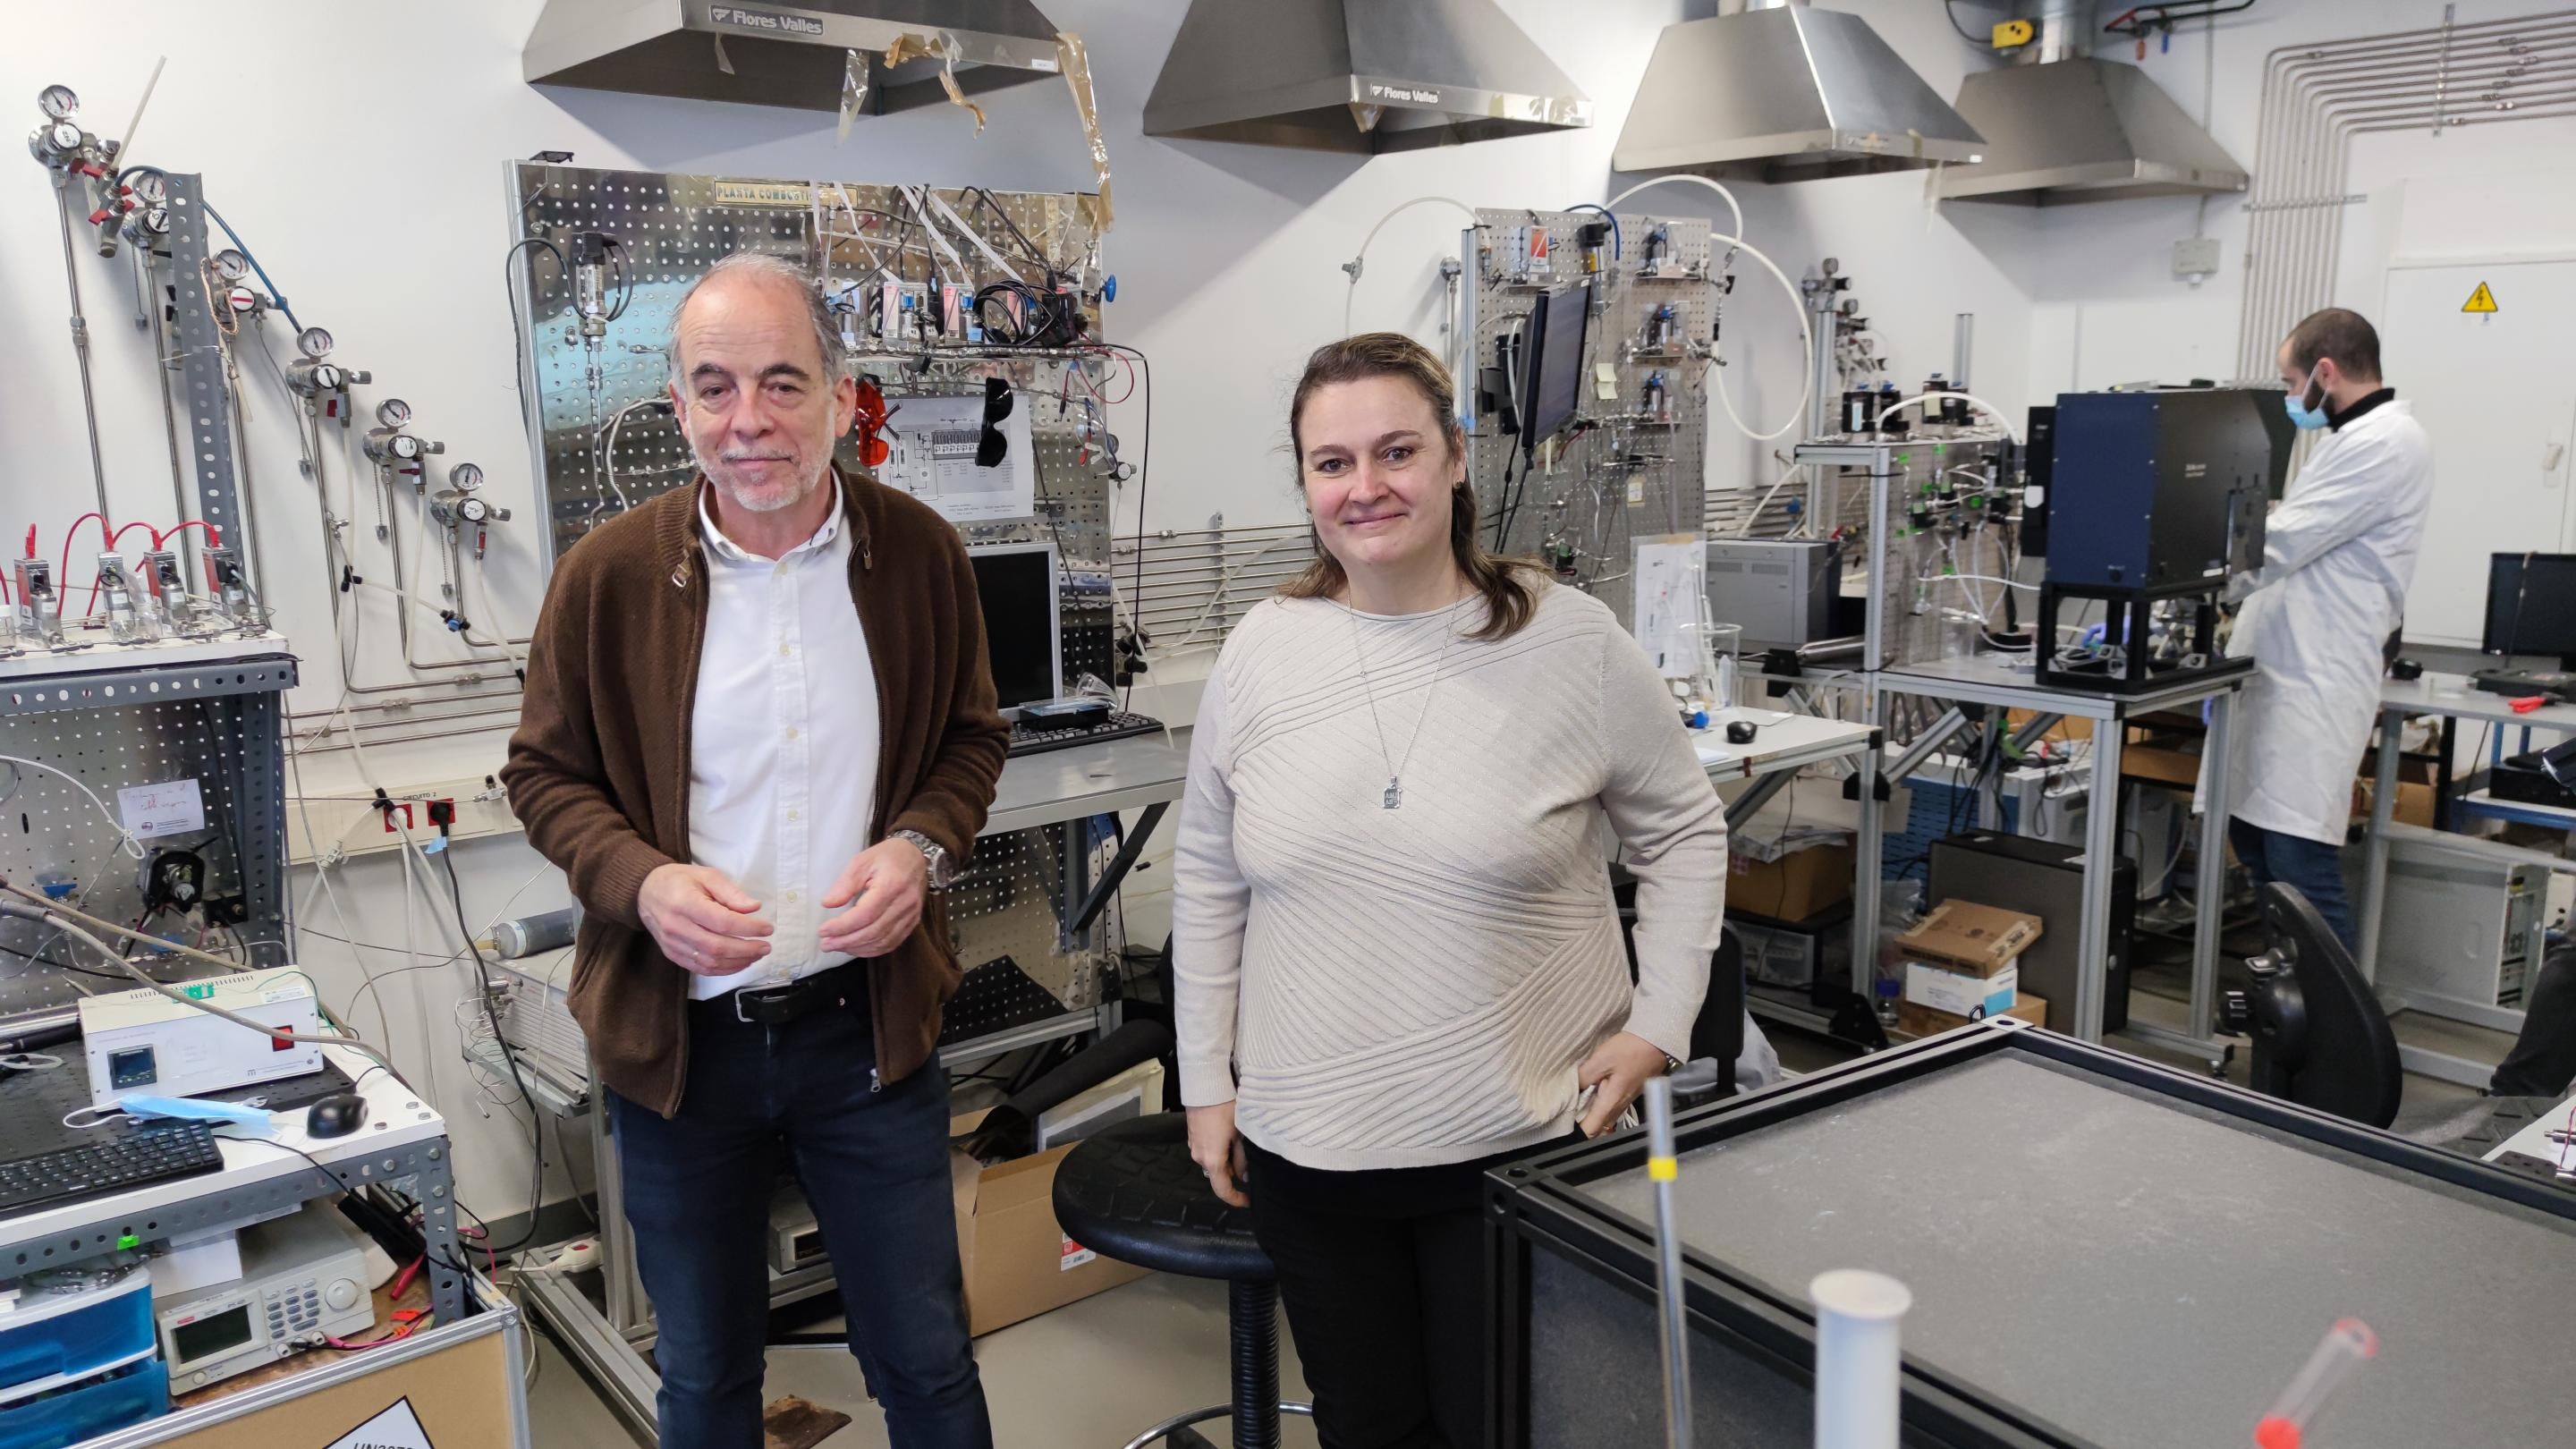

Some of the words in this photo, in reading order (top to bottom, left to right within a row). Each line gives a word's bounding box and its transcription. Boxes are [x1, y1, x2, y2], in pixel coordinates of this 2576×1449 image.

[733, 10, 777, 29] Flores
[780, 16, 822, 34] Valles
[1384, 86, 1411, 100] Flores
[1412, 89, 1438, 104] Valles
[716, 185, 756, 199] PLANTA
